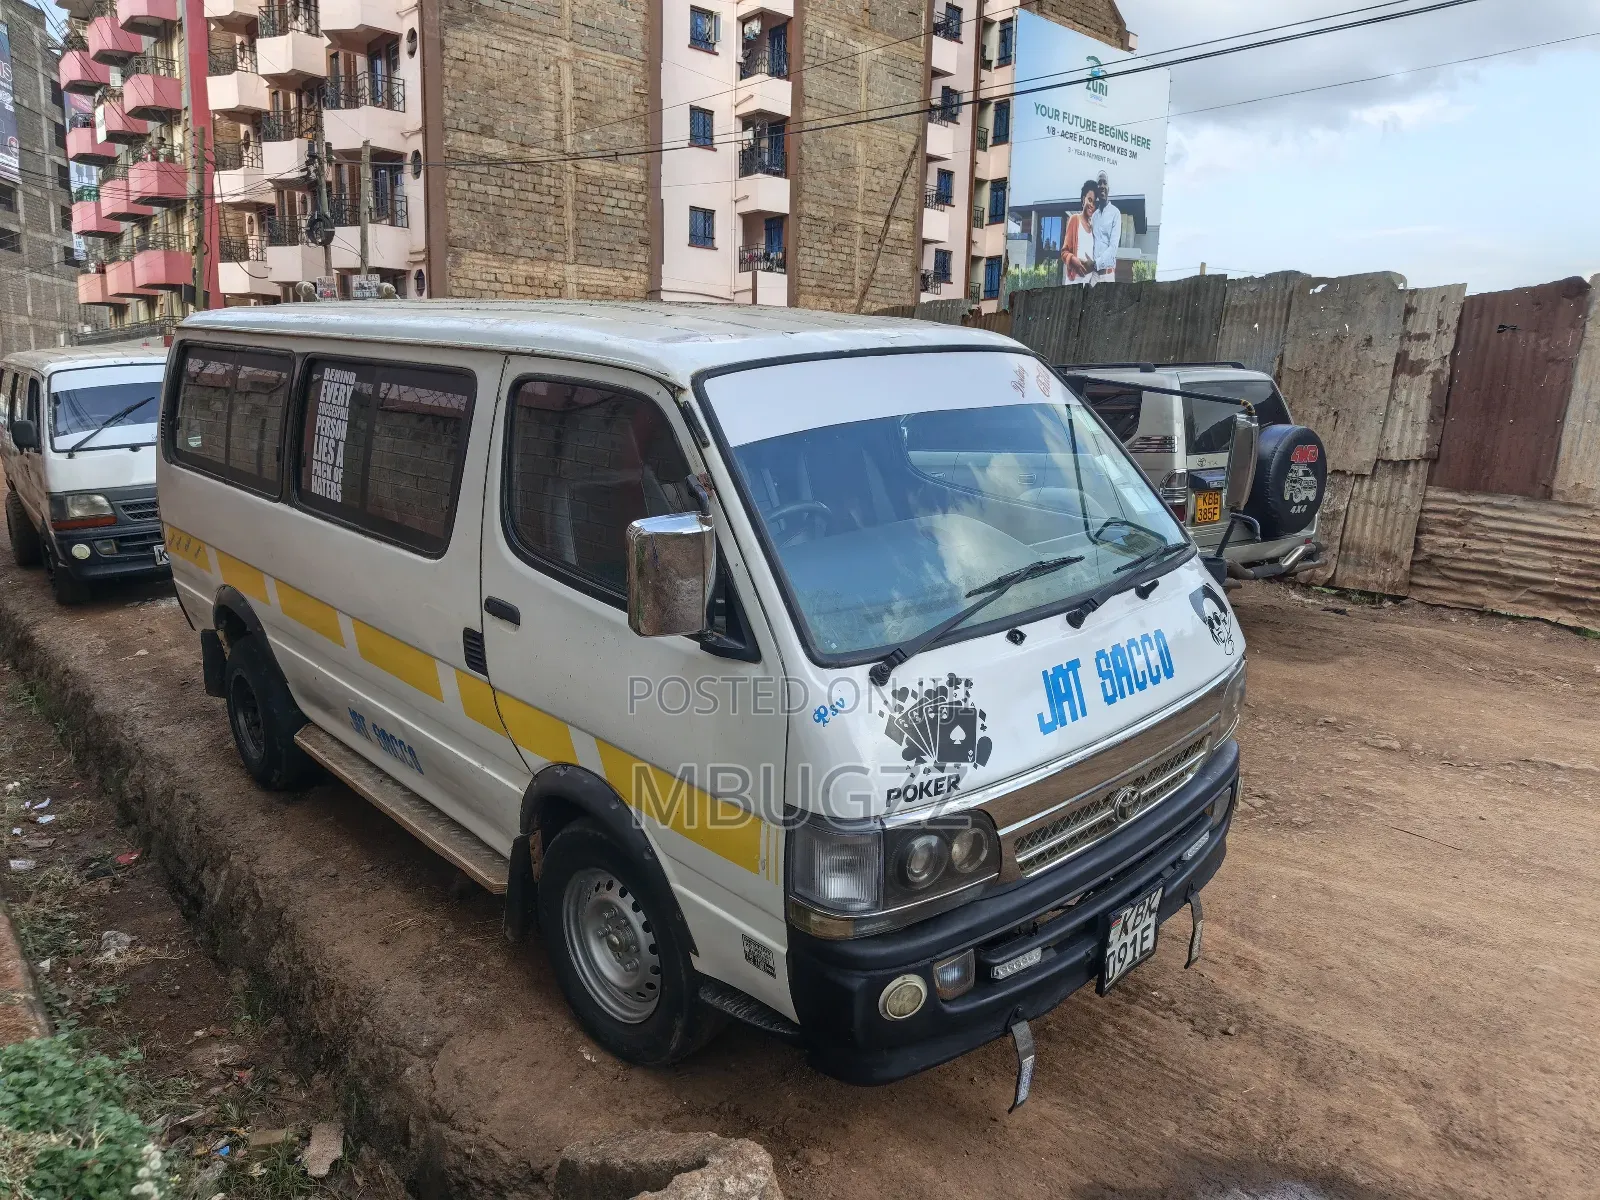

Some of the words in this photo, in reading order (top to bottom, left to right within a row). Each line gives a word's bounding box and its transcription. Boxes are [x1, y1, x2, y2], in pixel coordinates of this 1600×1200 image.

[1086, 79, 1108, 96] ZURI
[1034, 102, 1060, 121] YOUR
[1062, 111, 1097, 132] FUTURE
[1098, 122, 1129, 142] BEGINS
[1130, 134, 1152, 150] HERE
[1046, 125, 1056, 135] 1/8
[1060, 130, 1078, 141] ACRE
[1078, 135, 1098, 148] PLOTS
[1098, 141, 1116, 153] FROM
[1116, 147, 1128, 157] KES
[1128, 152, 1138, 160] 3M
[1074, 149, 1086, 157] YEAR
[1086, 153, 1106, 162] PAYMENT
[323, 367, 356, 385] BEHIND
[320, 381, 354, 407] EVERY
[315, 415, 348, 441] PERSON
[313, 434, 335, 465] LIES
[335, 441, 345, 468] A
[312, 460, 333, 479] PACK
[333, 467, 344, 484] OF
[311, 475, 342, 503] HATERS
[1202, 492, 1219, 505] KBG
[1198, 507, 1218, 522] 385F
[1037, 658, 1088, 736] JAT
[1094, 628, 1175, 707] SACCO
[348, 706, 373, 742] JAT
[886, 773, 960, 807] POKER
